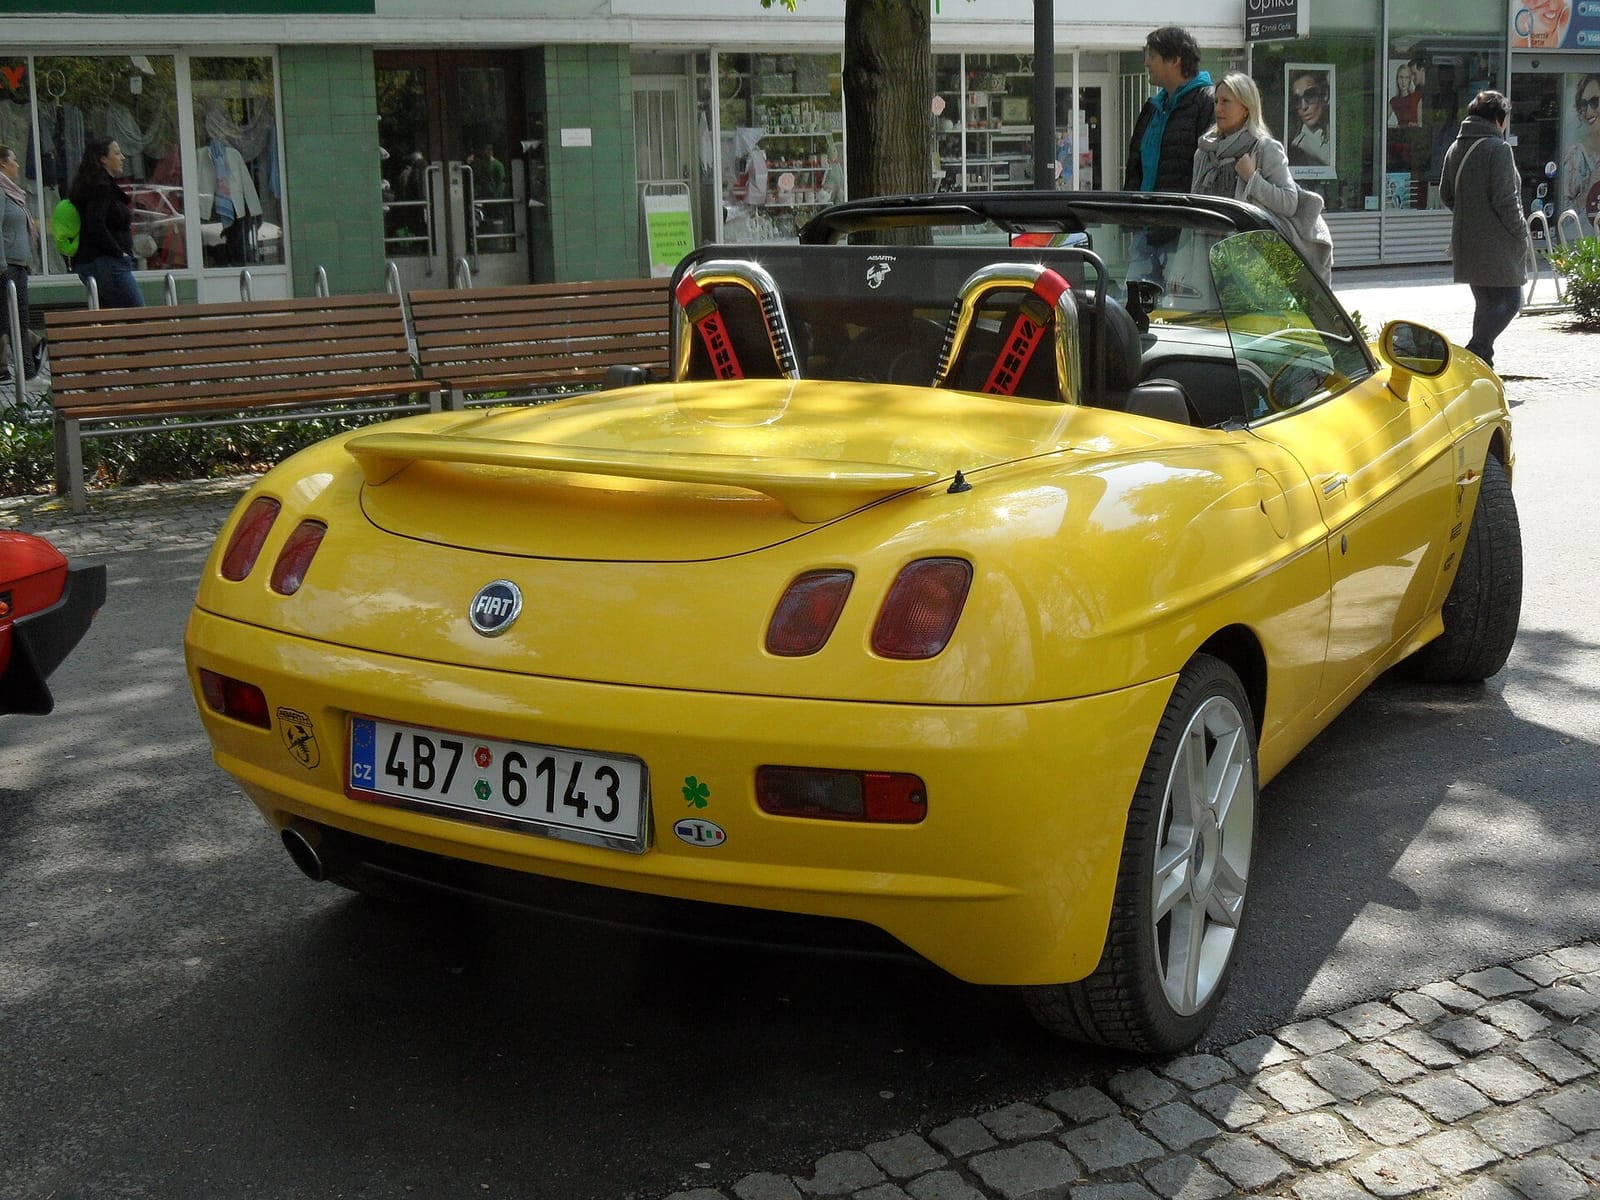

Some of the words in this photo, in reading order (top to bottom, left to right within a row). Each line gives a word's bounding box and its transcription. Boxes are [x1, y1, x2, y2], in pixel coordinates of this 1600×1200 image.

[0, 66, 26, 90] Y
[475, 595, 513, 617] FIAT
[353, 763, 372, 781] CZ
[385, 732, 464, 794] 4B7
[502, 751, 620, 823] 6143
